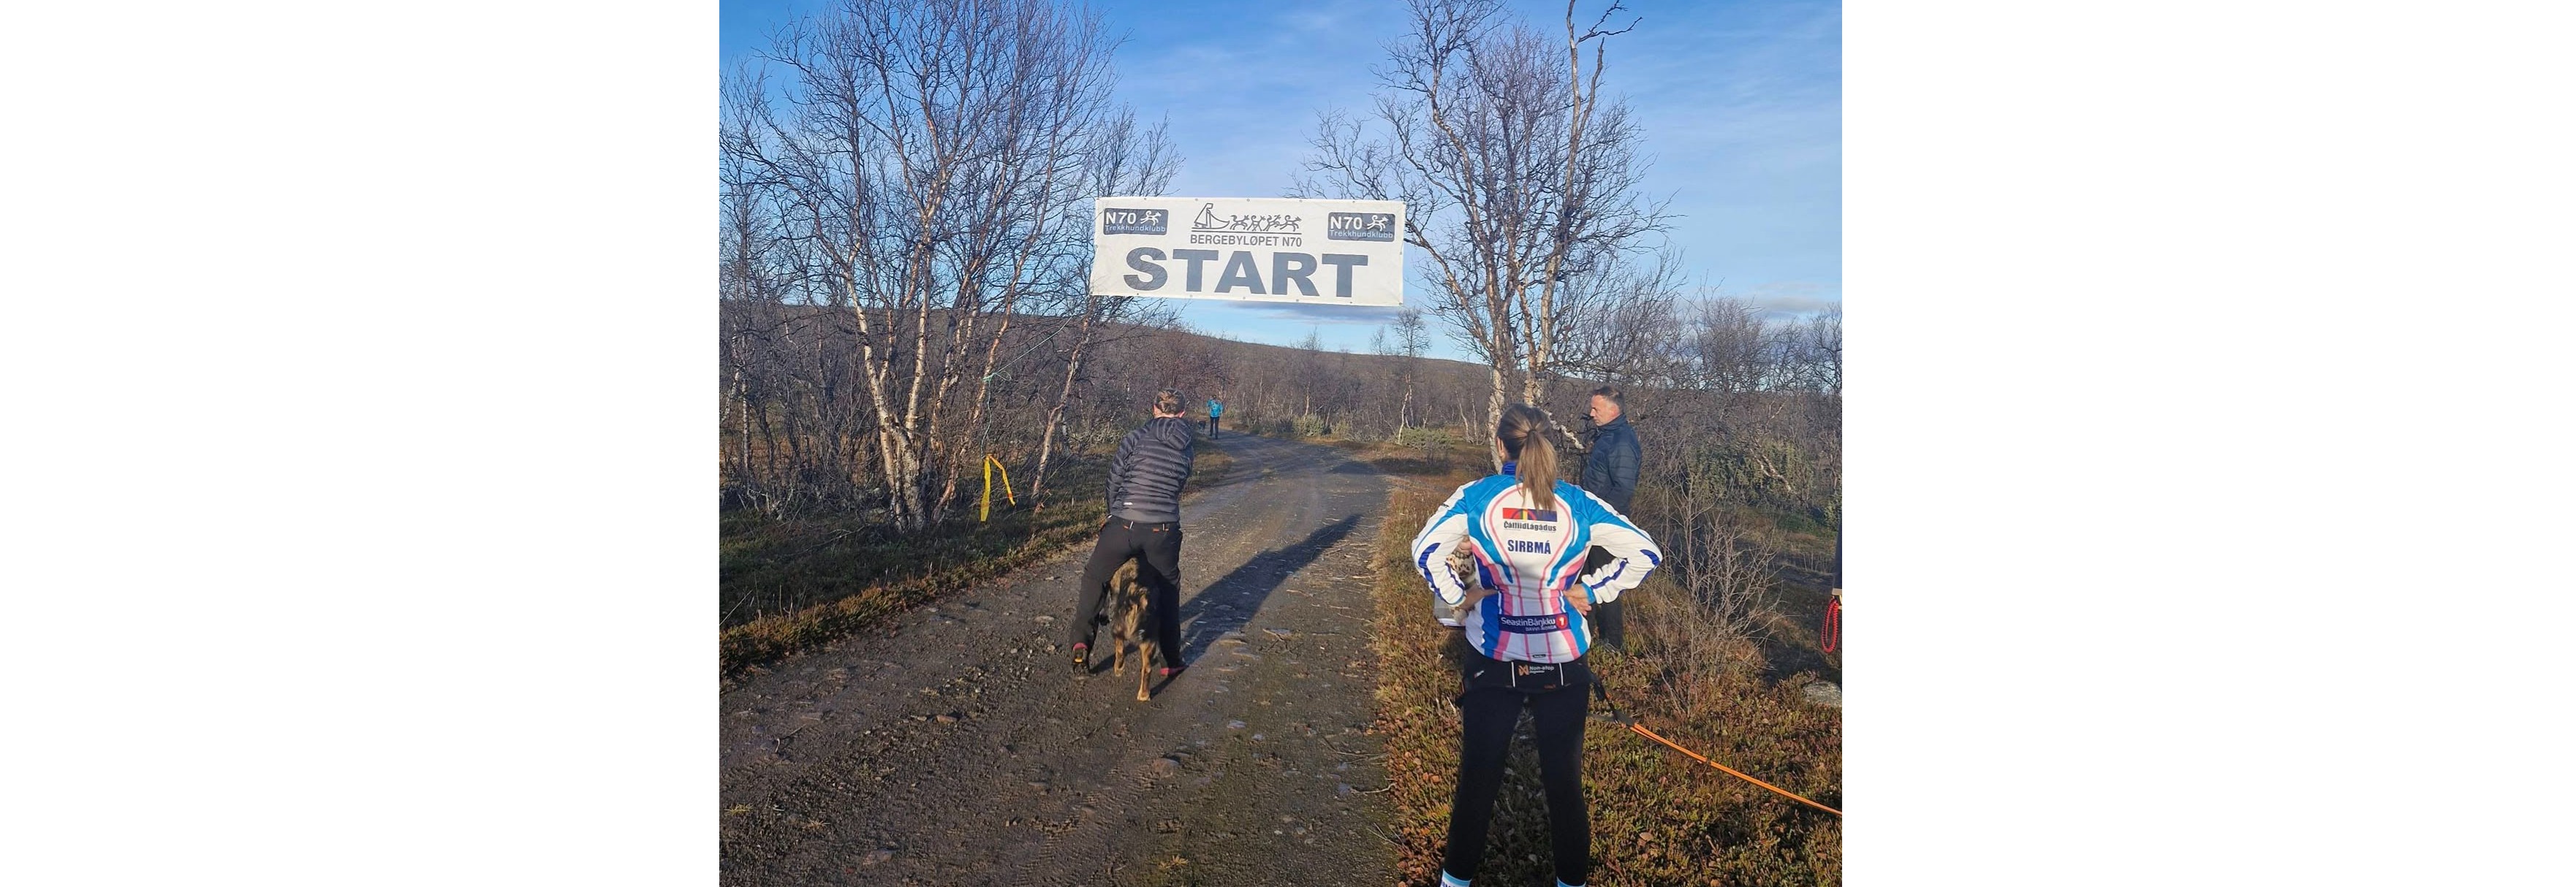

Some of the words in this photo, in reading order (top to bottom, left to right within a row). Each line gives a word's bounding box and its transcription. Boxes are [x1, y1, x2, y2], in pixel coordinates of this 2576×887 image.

[1105, 212, 1137, 224] N70
[1330, 216, 1363, 230] N70
[1329, 229, 1393, 238] Trekkhundklubb
[1190, 234, 1279, 247] BERGEBYLØPET
[1282, 237, 1302, 248] N70
[1124, 246, 1368, 297] START
[1507, 539, 1551, 555] SIRBMÁ
[1558, 617, 1564, 626] 1
